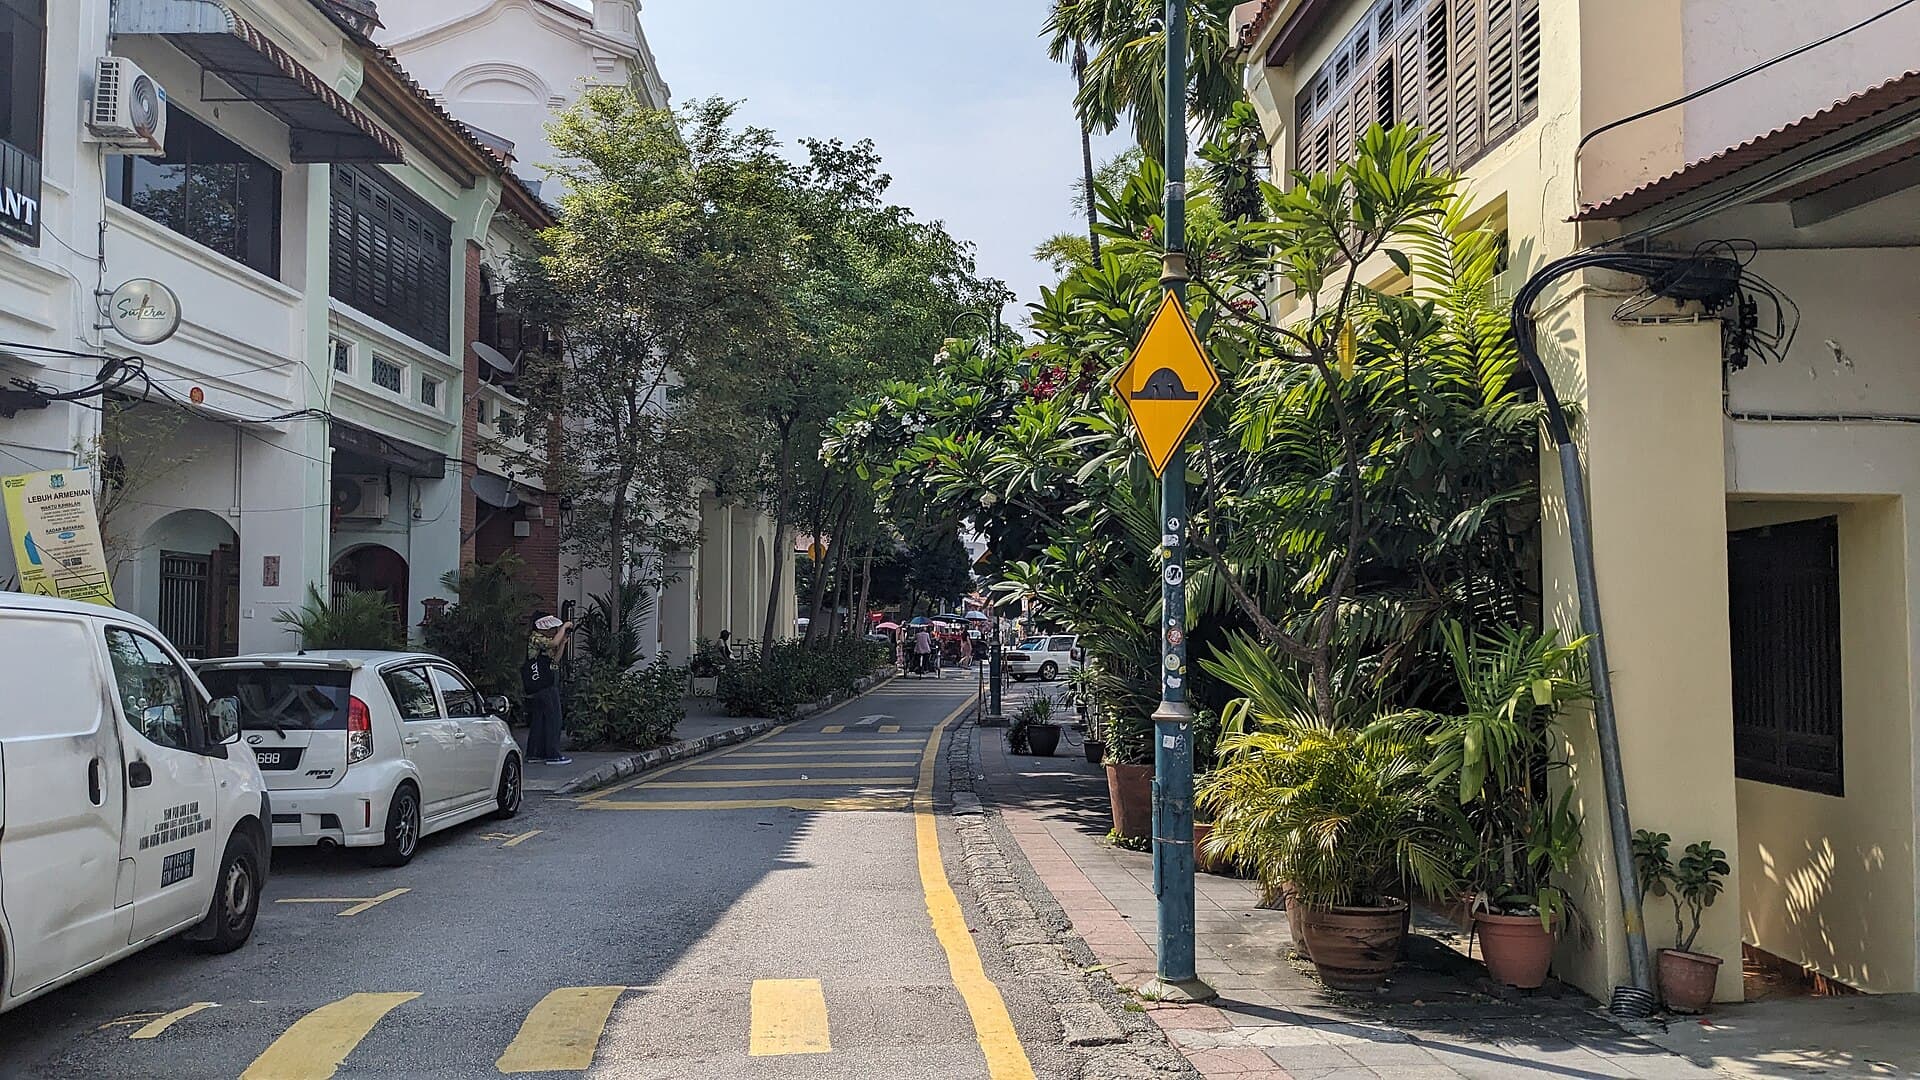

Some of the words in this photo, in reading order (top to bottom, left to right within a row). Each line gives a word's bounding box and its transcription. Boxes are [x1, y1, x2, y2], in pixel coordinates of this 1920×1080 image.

[117, 294, 167, 320] Sutera
[28, 494, 52, 504] LEBUH
[54, 489, 91, 500] ARMENIAN
